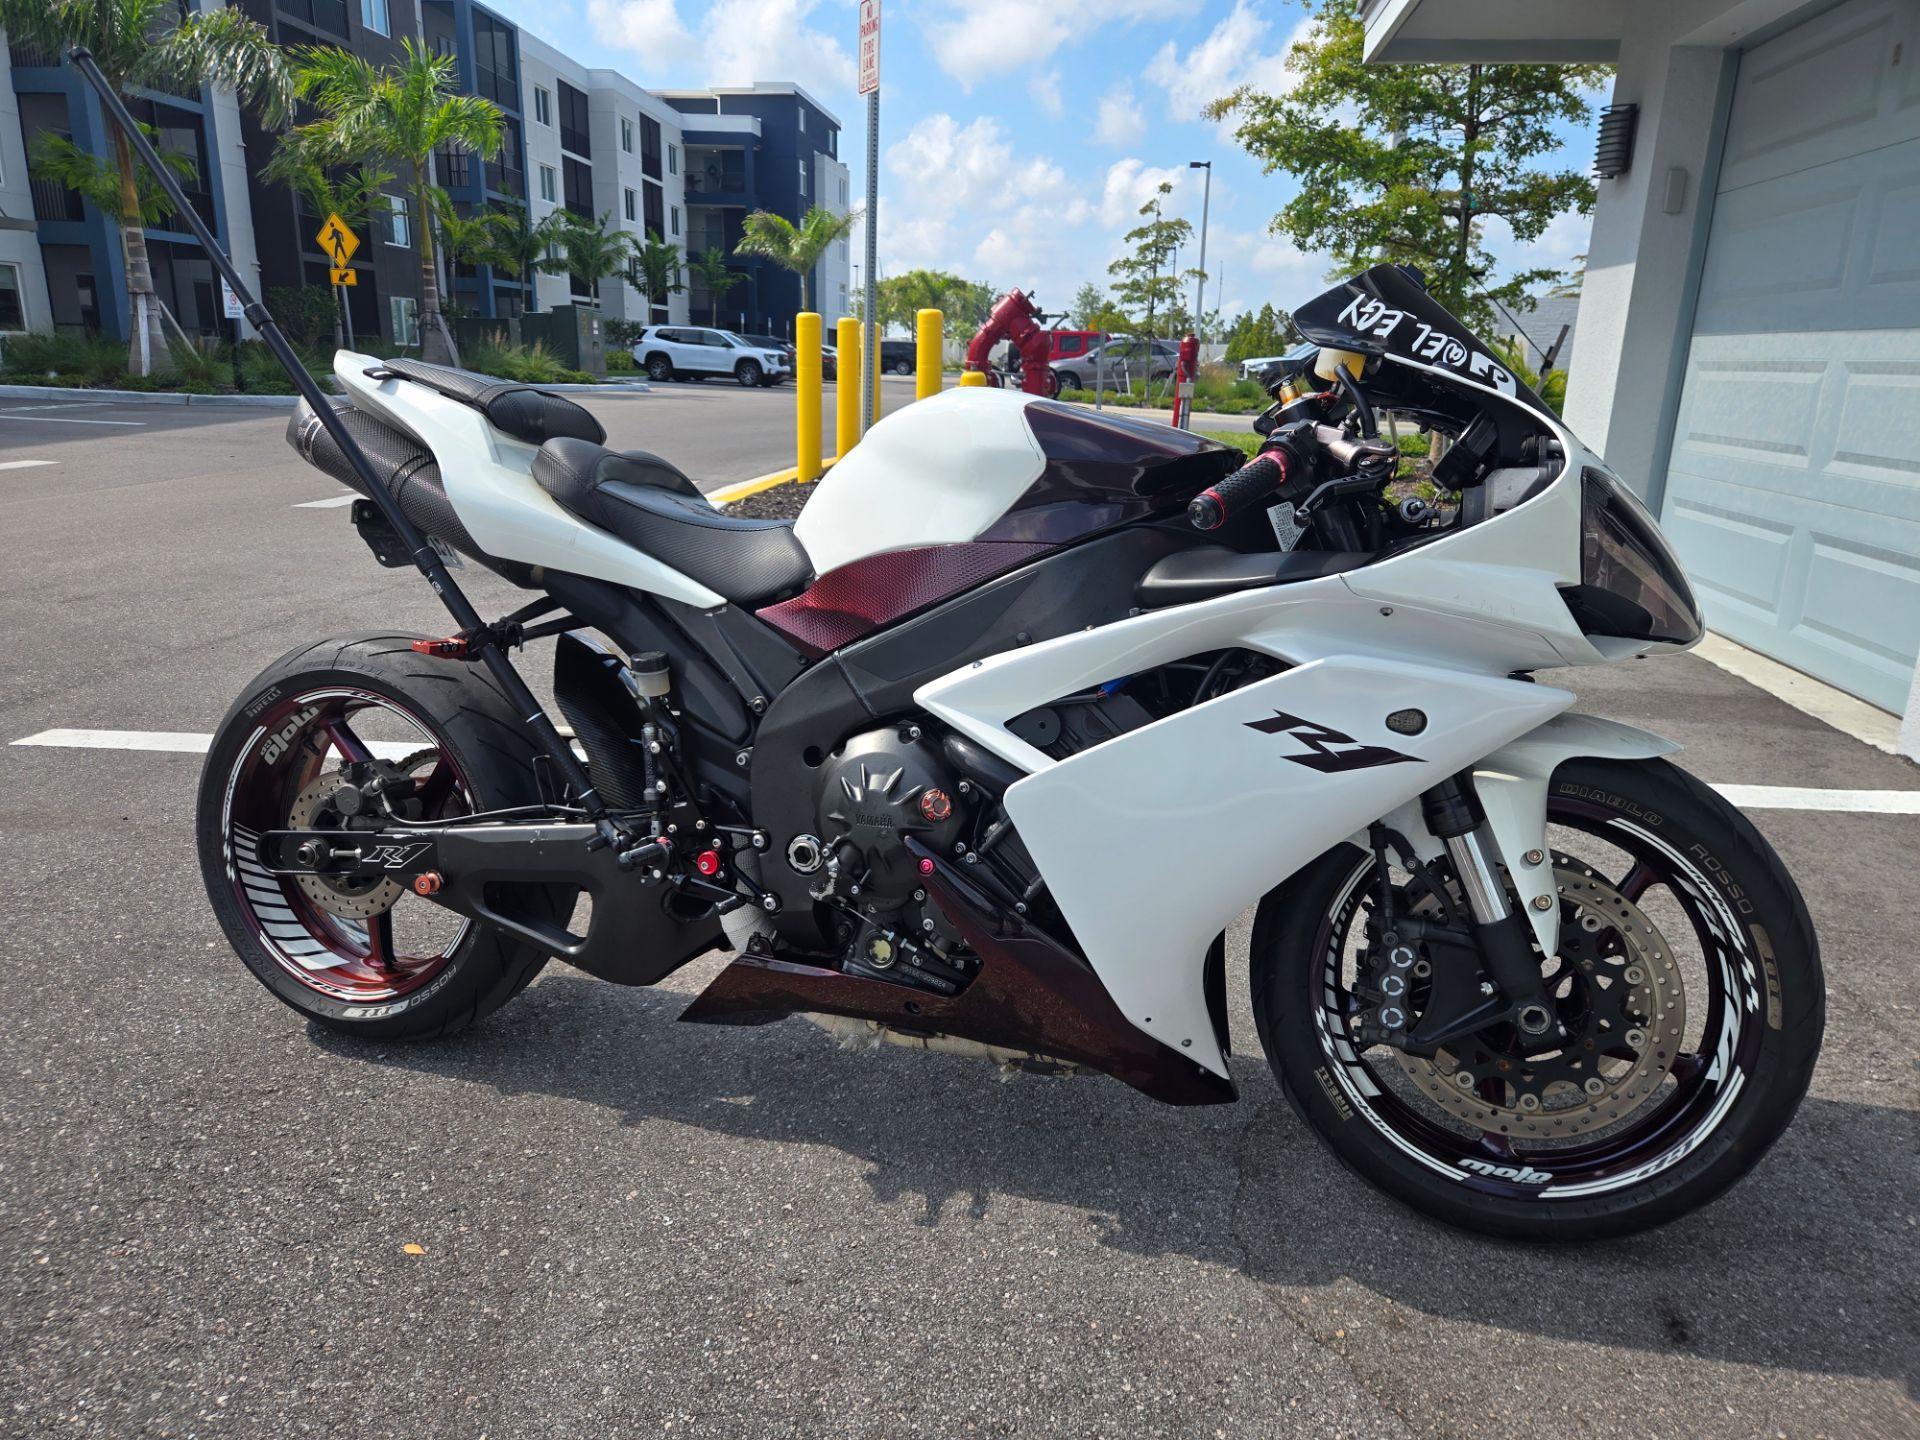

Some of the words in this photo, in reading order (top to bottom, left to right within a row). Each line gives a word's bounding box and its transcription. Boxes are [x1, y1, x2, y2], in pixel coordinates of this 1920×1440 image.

[863, 38, 875, 56] FIRE
[863, 54, 875, 73] LANE
[855, 813, 894, 829] YAMAHA
[361, 842, 433, 869] R1
[1559, 783, 1663, 827] DIABLO
[1690, 843, 1754, 915] ROSSO
[410, 964, 457, 1007] ROSSO
[1313, 1065, 1355, 1121] PIRELLI
[1457, 1157, 1553, 1184] moto
